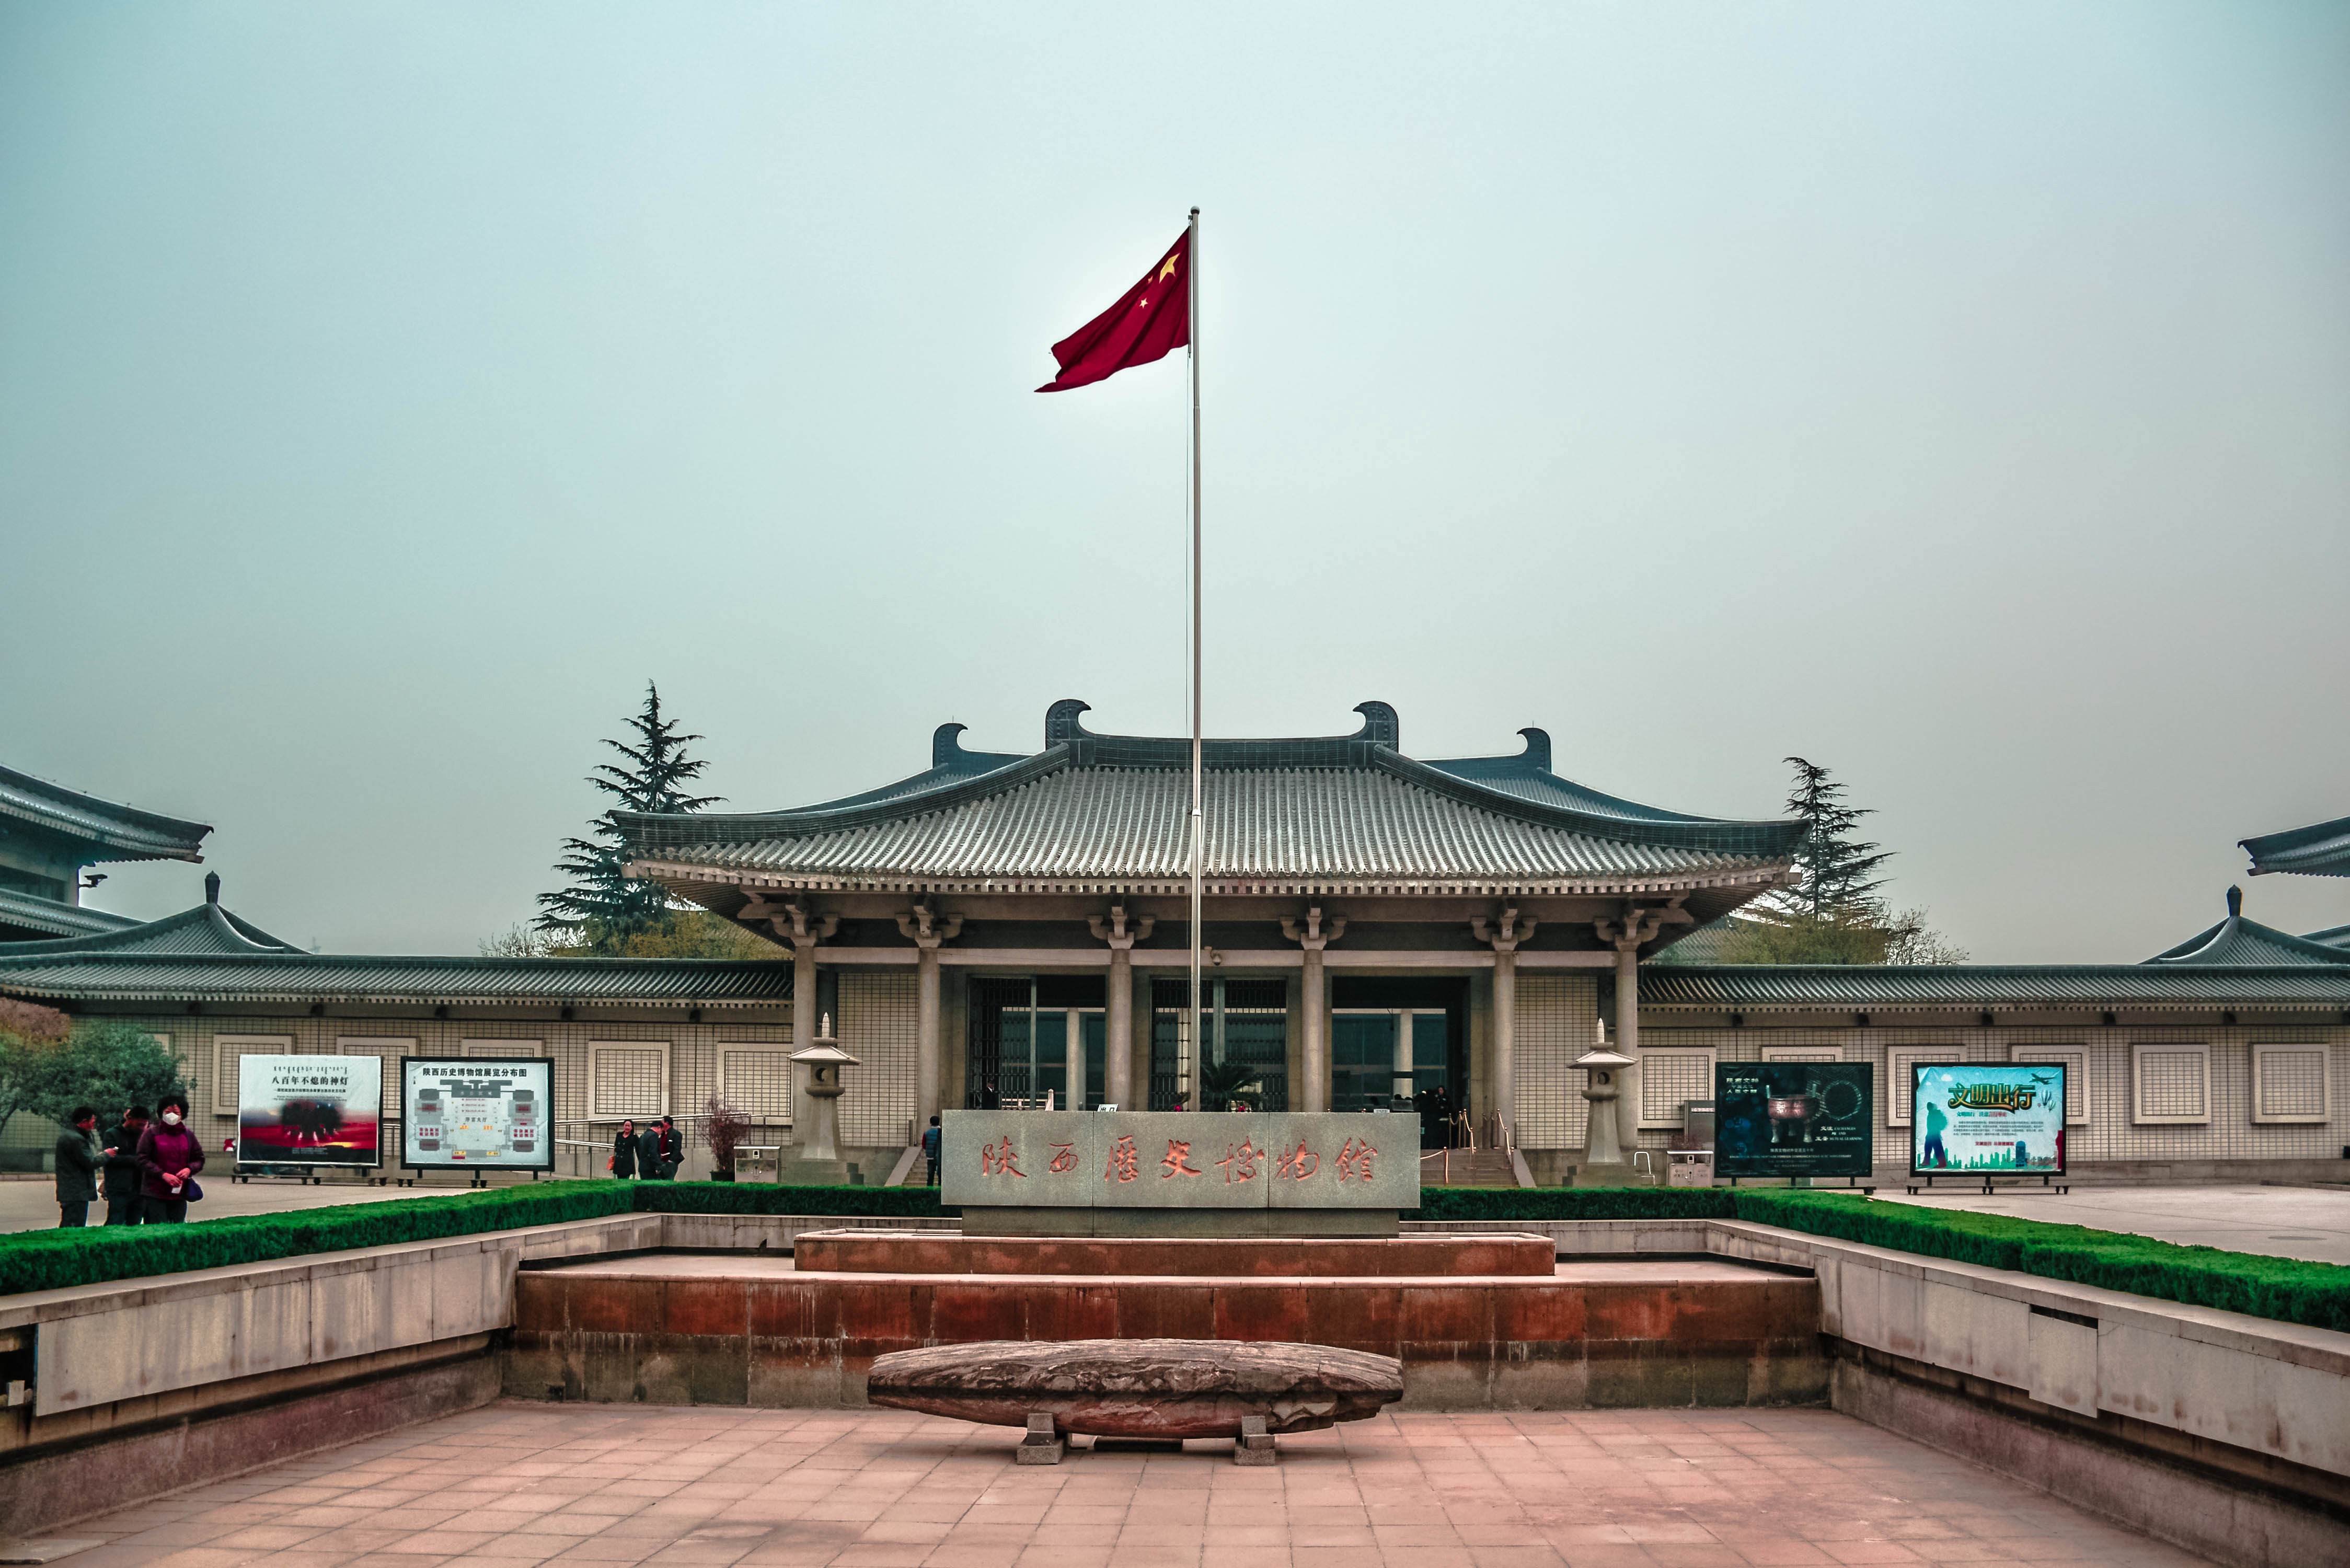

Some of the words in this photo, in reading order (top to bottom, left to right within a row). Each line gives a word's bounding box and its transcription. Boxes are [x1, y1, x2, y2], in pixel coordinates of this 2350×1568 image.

[422, 1068, 527, 1077] 陕西历史博物馆展览分布图
[272, 1076, 349, 1086] 八百年不熄的神灯
[1948, 1082, 2036, 1114] 文明出行
